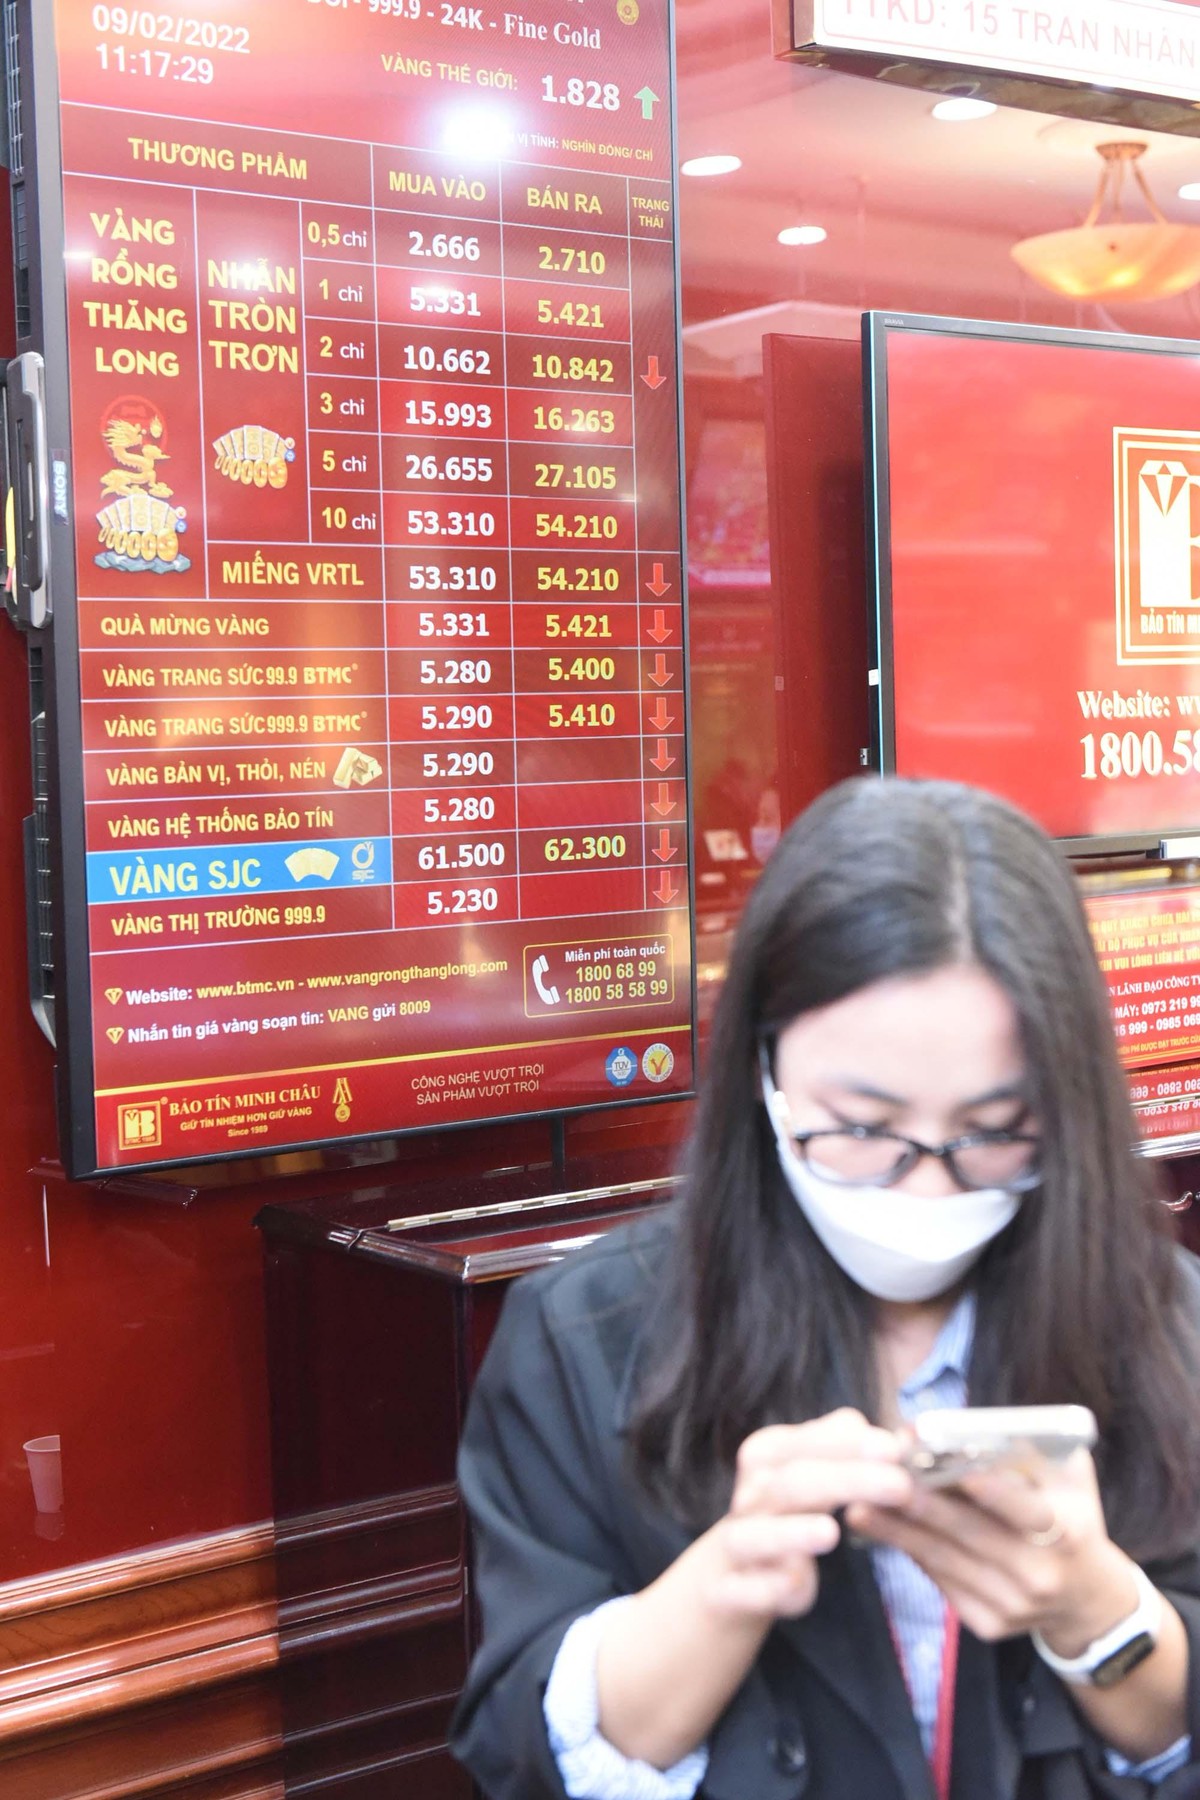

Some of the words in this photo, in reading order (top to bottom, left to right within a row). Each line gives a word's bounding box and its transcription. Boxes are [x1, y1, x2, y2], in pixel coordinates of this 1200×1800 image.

[93, 6, 250, 53] 09/02/2022
[440, 3, 484, 31] 24K
[504, 13, 548, 40] Fine
[553, 22, 601, 50] Gold
[963, 1, 998, 35] 15
[96, 44, 214, 84] 11:17:29
[381, 52, 432, 77] VÀNG
[436, 63, 471, 84] THẾ
[476, 68, 518, 90] GIỚI:
[541, 75, 620, 111] 1.828
[128, 137, 235, 171] THƯƠNG
[242, 152, 307, 180] PHẨM
[389, 171, 436, 196] MUA
[441, 174, 486, 201] VÀO
[527, 185, 569, 211] BÁN
[575, 193, 602, 215] RA
[632, 197, 670, 213] TRẠNG
[90, 207, 175, 245] VÀNG
[308, 221, 340, 248] 0,5
[342, 230, 367, 248] chỉ
[638, 213, 664, 229] THÁI
[408, 231, 480, 261] 2.666
[91, 248, 177, 289] RỒNG
[538, 246, 606, 275] 2.710
[207, 258, 295, 294] NHẪN
[318, 278, 329, 300] 1
[338, 285, 363, 303] chỉ
[409, 287, 481, 316] 5.331
[83, 299, 187, 334] THĂNG
[208, 297, 296, 334] TRÒN
[537, 300, 604, 328] 5.421
[208, 340, 298, 374] TRƠN
[319, 336, 333, 358] 2
[340, 342, 365, 360] chỉ
[404, 346, 491, 375] 10.662
[95, 347, 179, 377] LONG
[532, 354, 614, 383] 10.842
[320, 392, 333, 414] 3
[340, 398, 365, 416] chỉ
[405, 400, 492, 428] 15.993
[533, 406, 615, 433] 16.263
[322, 450, 335, 472] 5
[342, 455, 367, 473] chỉ
[405, 455, 493, 482] 26.655
[52, 460, 69, 518] SONY
[534, 463, 617, 490] 27.105
[322, 507, 347, 529] 10
[352, 513, 376, 531] chỉ
[407, 510, 495, 536] 53.310
[535, 513, 618, 539] 54.210
[222, 550, 300, 585] MIẾNG
[306, 563, 364, 585] VRTL
[409, 566, 497, 591] 53.310
[537, 567, 620, 592] 54.210
[100, 613, 145, 636] QUÀ
[150, 613, 210, 635] MỪNG
[215, 613, 270, 635] VÀNG
[419, 613, 490, 637] 5.331
[545, 614, 612, 639] 5.421
[1140, 607, 1164, 634] BẢO
[1166, 610, 1185, 634] TÍN
[103, 663, 155, 687] VÀNG
[160, 668, 223, 686] TRANG
[420, 660, 491, 684] 5.280
[548, 657, 615, 681] 5.400
[421, 705, 493, 730] 5.290
[549, 703, 616, 728] 5.410
[1076, 689, 1171, 720] Website:
[104, 714, 157, 737] VÀNG
[161, 718, 224, 736] TRANG
[106, 763, 158, 786] VÀNG
[164, 760, 201, 784] BẢN
[206, 764, 231, 786] VỊ,
[236, 757, 284, 782] THỎI,
[289, 757, 326, 779] NÉN
[422, 752, 494, 777] 5.290
[108, 814, 160, 838] VÀNG
[165, 813, 192, 838] HỆ
[196, 806, 259, 833] THỐNG
[264, 807, 300, 830] BẢO
[305, 806, 334, 828] TÍN
[424, 796, 495, 822] 5.280
[418, 842, 505, 870] 61.500
[544, 835, 626, 861] 62.300
[109, 856, 198, 896] VÀNG
[208, 858, 262, 889] SJC
[427, 888, 498, 914] 5.230
[111, 912, 163, 936] VÀNG
[168, 913, 199, 934] THỊ
[204, 904, 280, 929] TRƯỜNG
[284, 905, 326, 926] 999.9
[565, 948, 591, 962] Miễn
[593, 947, 611, 962] phí
[613, 946, 636, 958] toàn
[639, 941, 666, 958] quốc
[126, 987, 192, 1005] Website:
[196, 979, 294, 998] www.btmc.vn
[306, 960, 508, 988] www.vangrongthanglong.com
[576, 964, 612, 983] 1800
[616, 962, 634, 979] 68
[638, 960, 656, 977] 99
[565, 985, 601, 1004] 1800
[606, 983, 624, 1000] 58
[628, 981, 646, 998] 58
[650, 979, 667, 995] 99
[1117, 982, 1142, 996] LÃNH
[1143, 979, 1163, 994] ĐẠO
[1164, 975, 1189, 989] CÔNG
[1141, 1000, 1167, 1015] 0973
[1169, 997, 1188, 1011] 219
[128, 1023, 169, 1043] Nhắn
[172, 1024, 192, 1038] tin
[195, 1021, 218, 1040] giá
[222, 1018, 258, 1034] vàng
[262, 1014, 297, 1031] soạn
[300, 1011, 324, 1025] tin:
[327, 1005, 369, 1022] VANG
[372, 1003, 396, 1021] gửi
[399, 1000, 431, 1015] 8009
[1128, 1021, 1148, 1035] 999
[1156, 1016, 1181, 1031] 0985
[411, 1075, 446, 1090] CÔNG
[448, 1071, 480, 1085] NGHỆ
[483, 1067, 516, 1081] VƯỢT
[518, 1063, 544, 1077] TRỘI
[169, 1098, 202, 1116] BẢO
[205, 1093, 231, 1112] TÍN
[235, 1090, 276, 1108] MINH
[279, 1084, 321, 1102] CHÂU
[416, 1092, 440, 1105] SẢN
[443, 1087, 475, 1101] PHẨM
[478, 1083, 511, 1097] VƯỢT
[513, 1080, 540, 1093] TRỘI
[287, 1105, 313, 1117] VÀNG
[227, 1127, 249, 1137] Since
